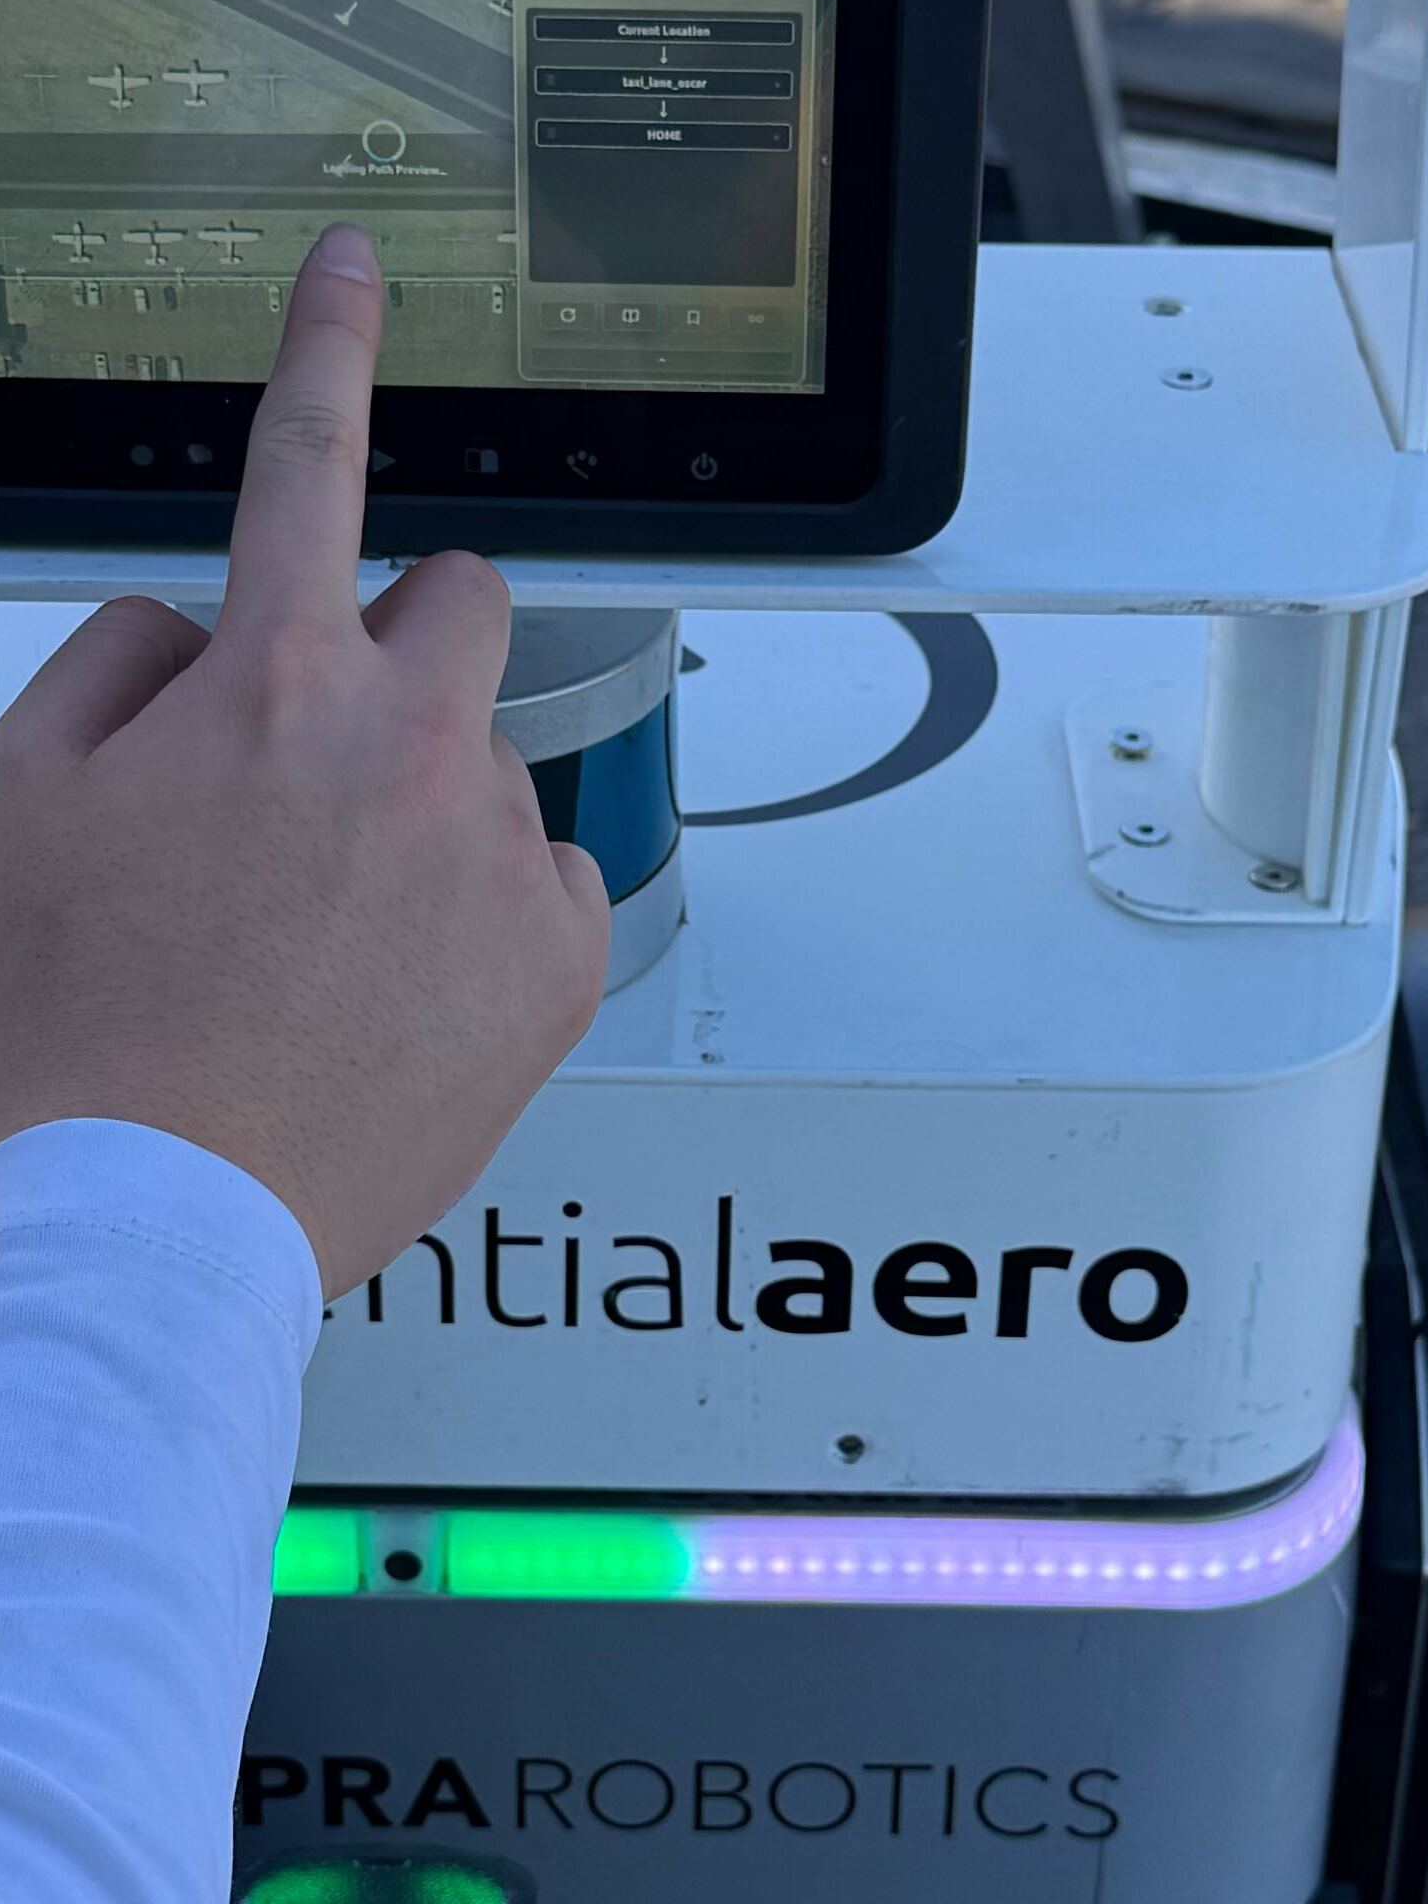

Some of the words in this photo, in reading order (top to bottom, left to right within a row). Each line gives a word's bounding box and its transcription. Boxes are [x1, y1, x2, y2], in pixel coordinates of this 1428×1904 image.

[618, 25, 661, 36] Current
[663, 25, 711, 38] Location
[647, 130, 682, 141] HOME
[322, 1195, 1189, 1343] ntialaero
